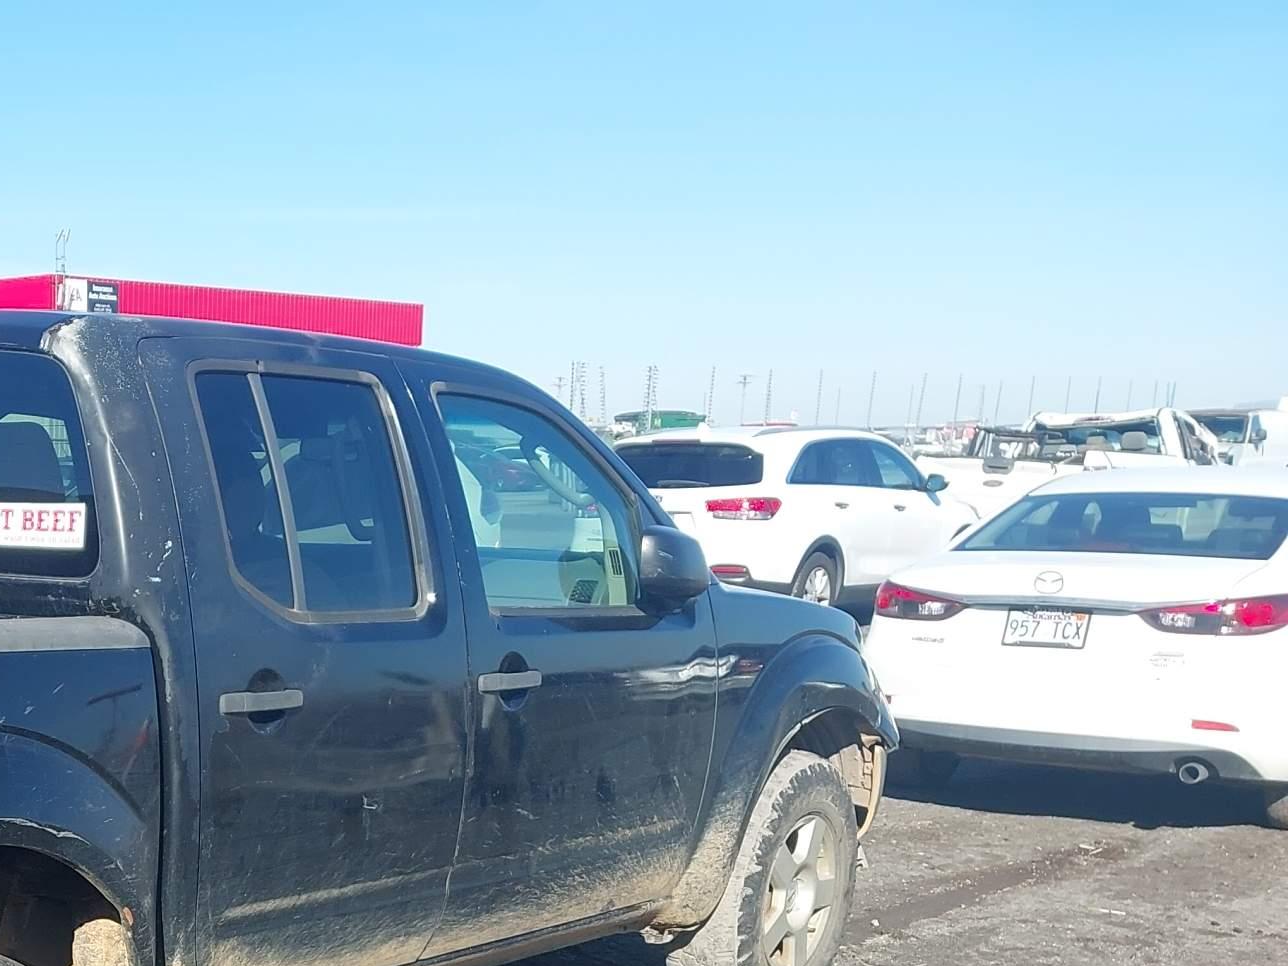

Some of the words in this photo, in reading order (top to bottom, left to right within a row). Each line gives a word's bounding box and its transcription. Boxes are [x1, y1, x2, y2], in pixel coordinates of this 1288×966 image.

[22, 509, 82, 532] BEEF
[1009, 618, 1040, 638] 957
[1052, 620, 1084, 641] TCX
